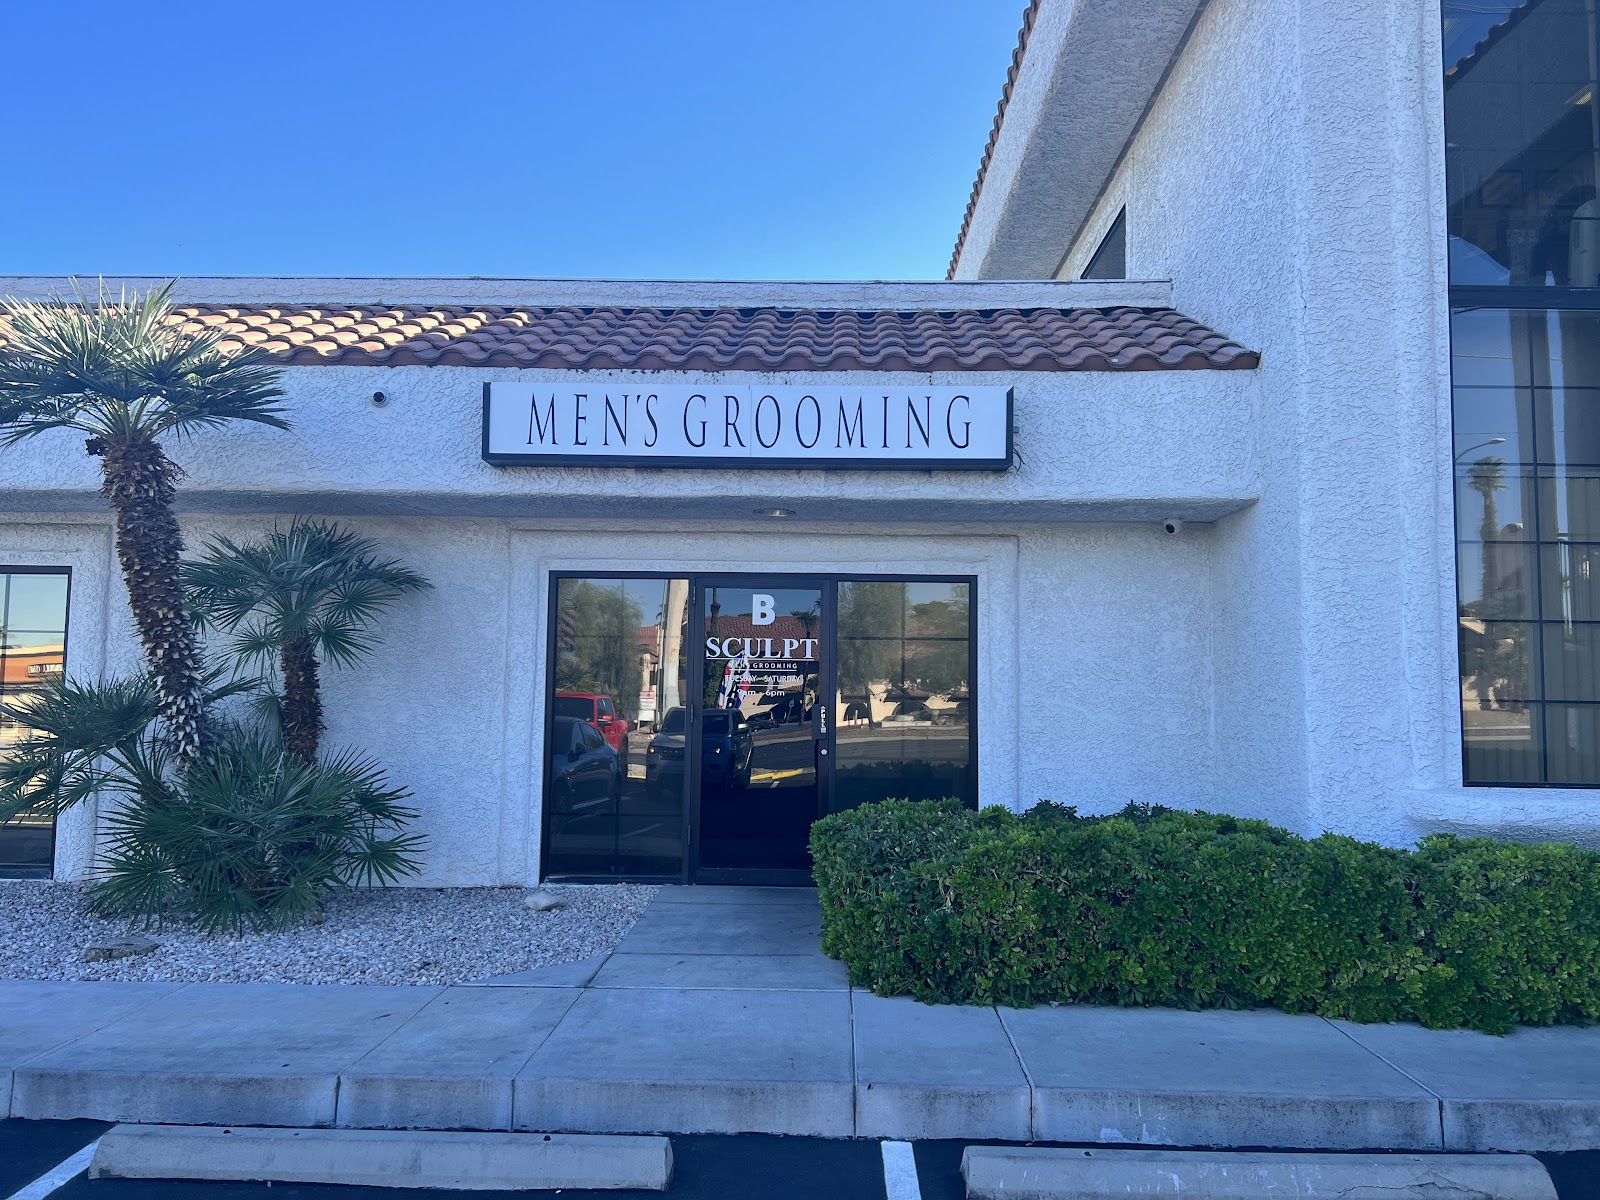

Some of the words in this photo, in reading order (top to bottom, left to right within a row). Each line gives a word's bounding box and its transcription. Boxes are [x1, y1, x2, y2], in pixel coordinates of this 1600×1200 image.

[526, 392, 659, 447] MEN'S
[683, 394, 972, 449] GROOMING
[752, 594, 776, 626] B
[706, 637, 818, 658] SCULPT
[765, 689, 785, 697] 6pm
